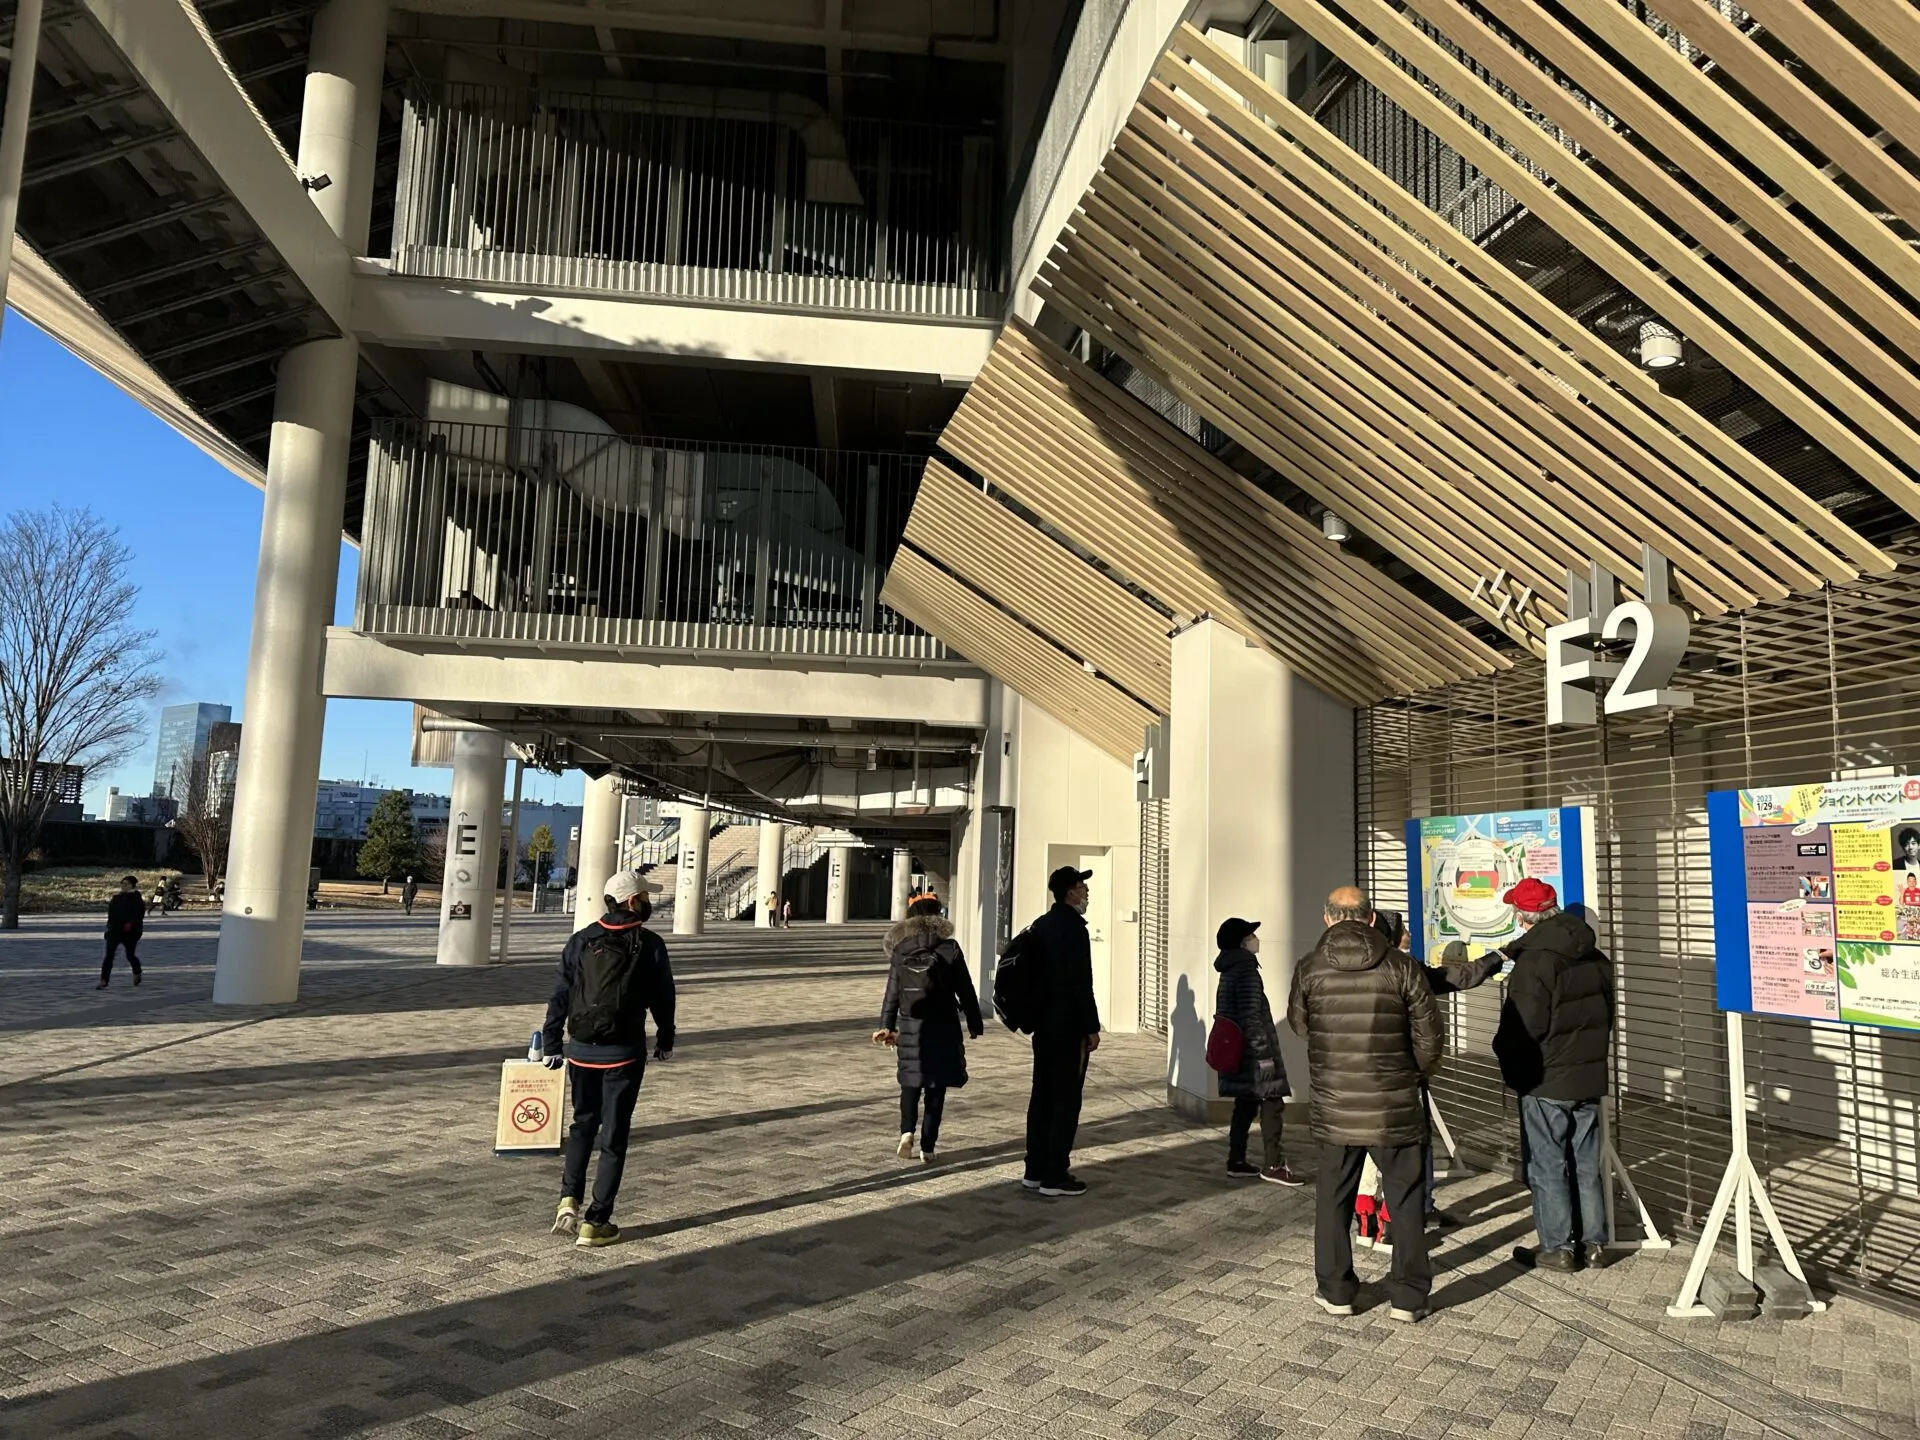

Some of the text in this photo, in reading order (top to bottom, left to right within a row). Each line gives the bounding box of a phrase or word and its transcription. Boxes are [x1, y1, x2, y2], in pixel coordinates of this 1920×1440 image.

[1546, 601, 1662, 725] F2
[1134, 747, 1154, 801] F1
[1757, 802, 1772, 811] 1/29
[1818, 790, 1906, 808] ジョイントイベント
[456, 824, 477, 855] E
[683, 851, 695, 869] E
[832, 864, 840, 877] E
